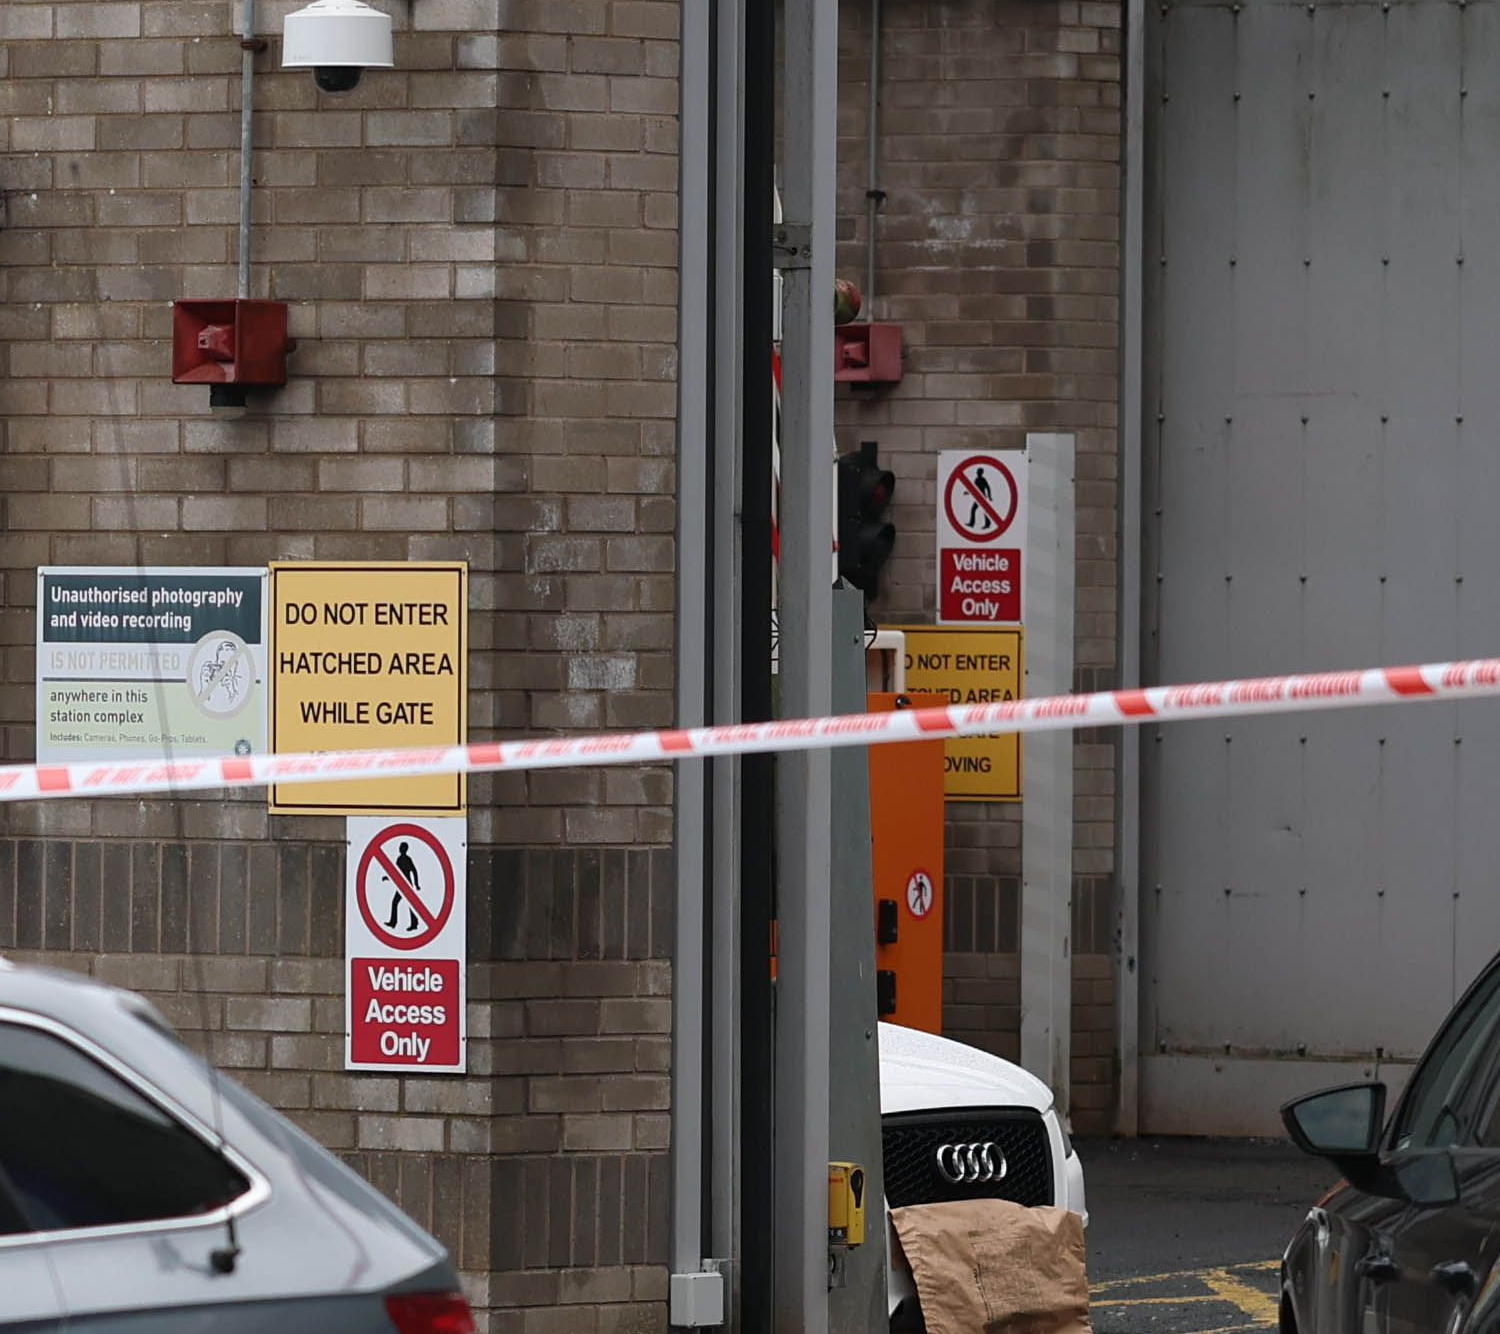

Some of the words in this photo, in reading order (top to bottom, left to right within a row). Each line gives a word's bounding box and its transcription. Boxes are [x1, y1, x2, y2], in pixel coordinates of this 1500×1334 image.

[953, 554, 1009, 571] Vehicle
[951, 576, 1011, 594] Access
[51, 586, 147, 604] Unauthorised
[152, 587, 243, 607] photography
[285, 603, 317, 625] DO
[324, 603, 368, 625] NOT
[375, 603, 448, 625] ENTER
[962, 598, 1000, 619] Only
[50, 611, 77, 627] and
[80, 611, 119, 627] video
[122, 612, 192, 632] recording
[51, 651, 64, 670] IS
[68, 651, 95, 670] NOT
[100, 652, 180, 671] PERMITTED
[280, 652, 382, 674] HATCHED
[388, 653, 454, 675] AREA
[918, 654, 952, 670] NOT
[955, 655, 1011, 671] ENTER
[50, 689, 108, 705] anywhere
[111, 690, 122, 702] in
[125, 690, 148, 703] this
[966, 689, 1013, 704] AREA
[50, 710, 90, 723] station
[94, 710, 144, 726] complex
[300, 701, 370, 724] WHILE
[376, 702, 433, 725] GATE
[50, 733, 82, 742] Includes:
[944, 757, 991, 773] OVING
[367, 966, 443, 992] Vehicle
[364, 998, 446, 1024] Access
[380, 1031, 431, 1062] Only
